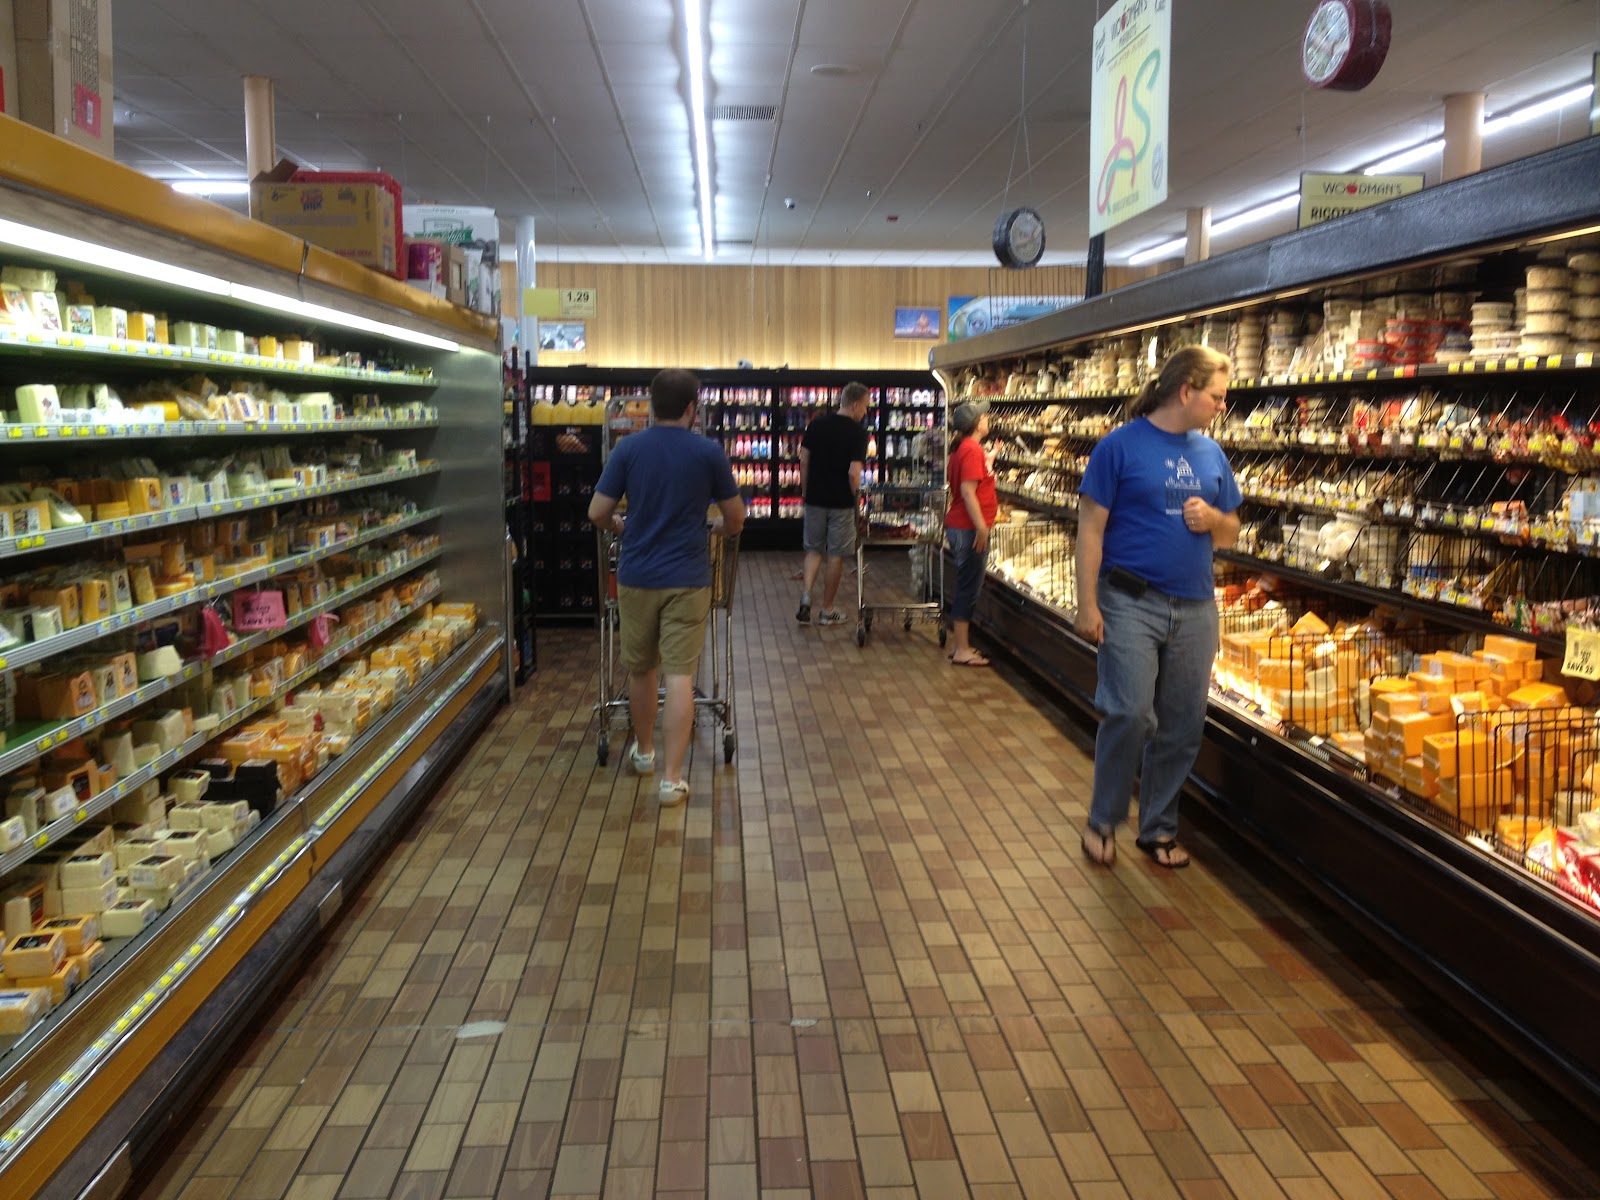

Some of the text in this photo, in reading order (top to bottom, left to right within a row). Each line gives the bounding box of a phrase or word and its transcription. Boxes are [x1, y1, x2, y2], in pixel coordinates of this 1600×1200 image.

[1323, 181, 1402, 195] WOODMAN'S
[567, 291, 589, 302] 1.29
[1566, 661, 1584, 672] SAVE
